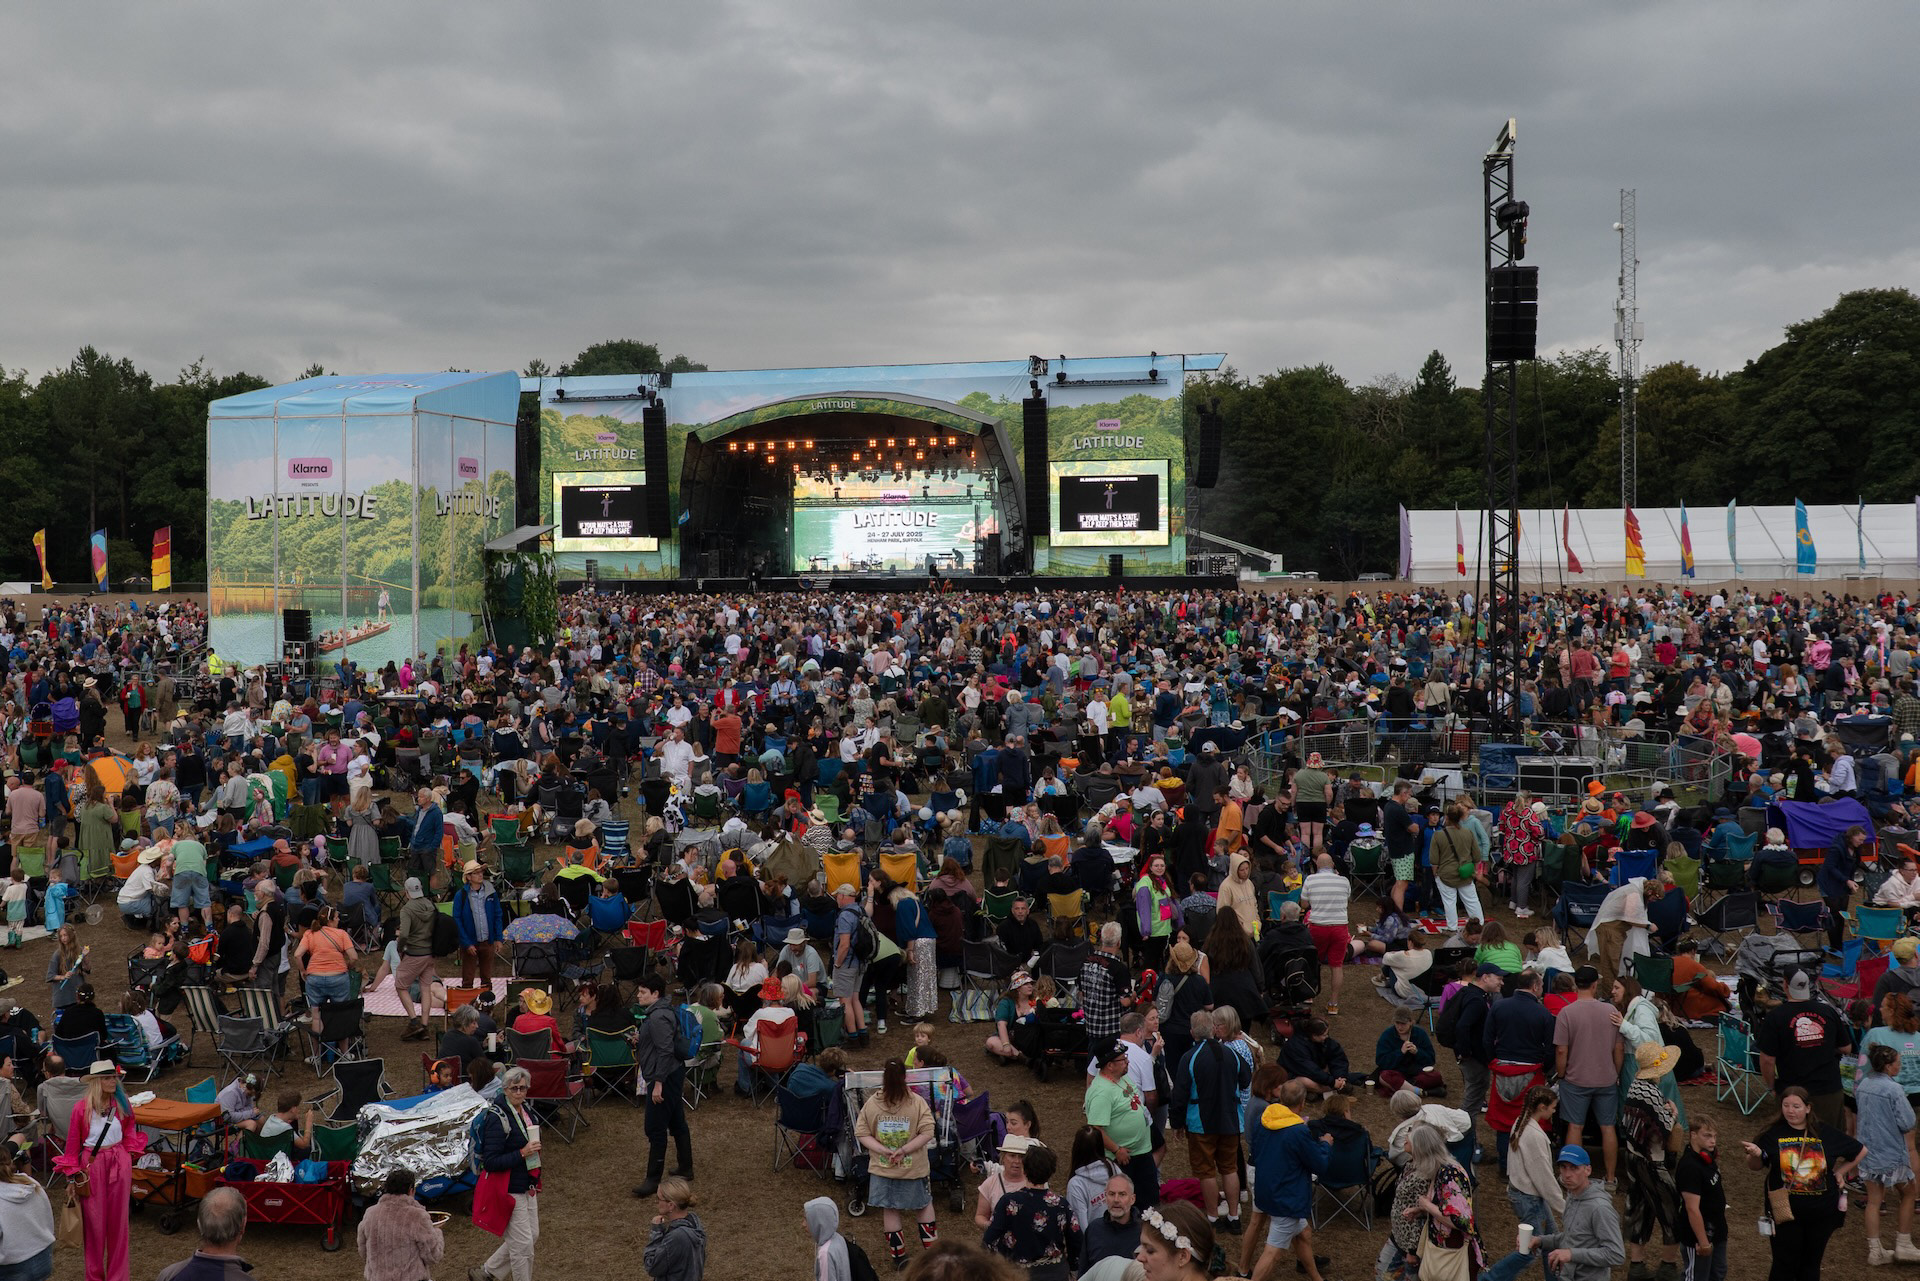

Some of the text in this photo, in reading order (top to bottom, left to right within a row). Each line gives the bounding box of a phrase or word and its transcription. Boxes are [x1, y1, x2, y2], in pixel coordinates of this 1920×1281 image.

[811, 400, 857, 410] LATITUDE
[1073, 435, 1144, 450] LATITUDE
[575, 448, 637, 461] LATITUDE
[293, 463, 328, 473] Klarna
[460, 463, 477, 473] Klarna
[244, 491, 378, 521] LATITUDE
[434, 490, 500, 520] LATITUDE
[851, 510, 939, 529] LATITUDE
